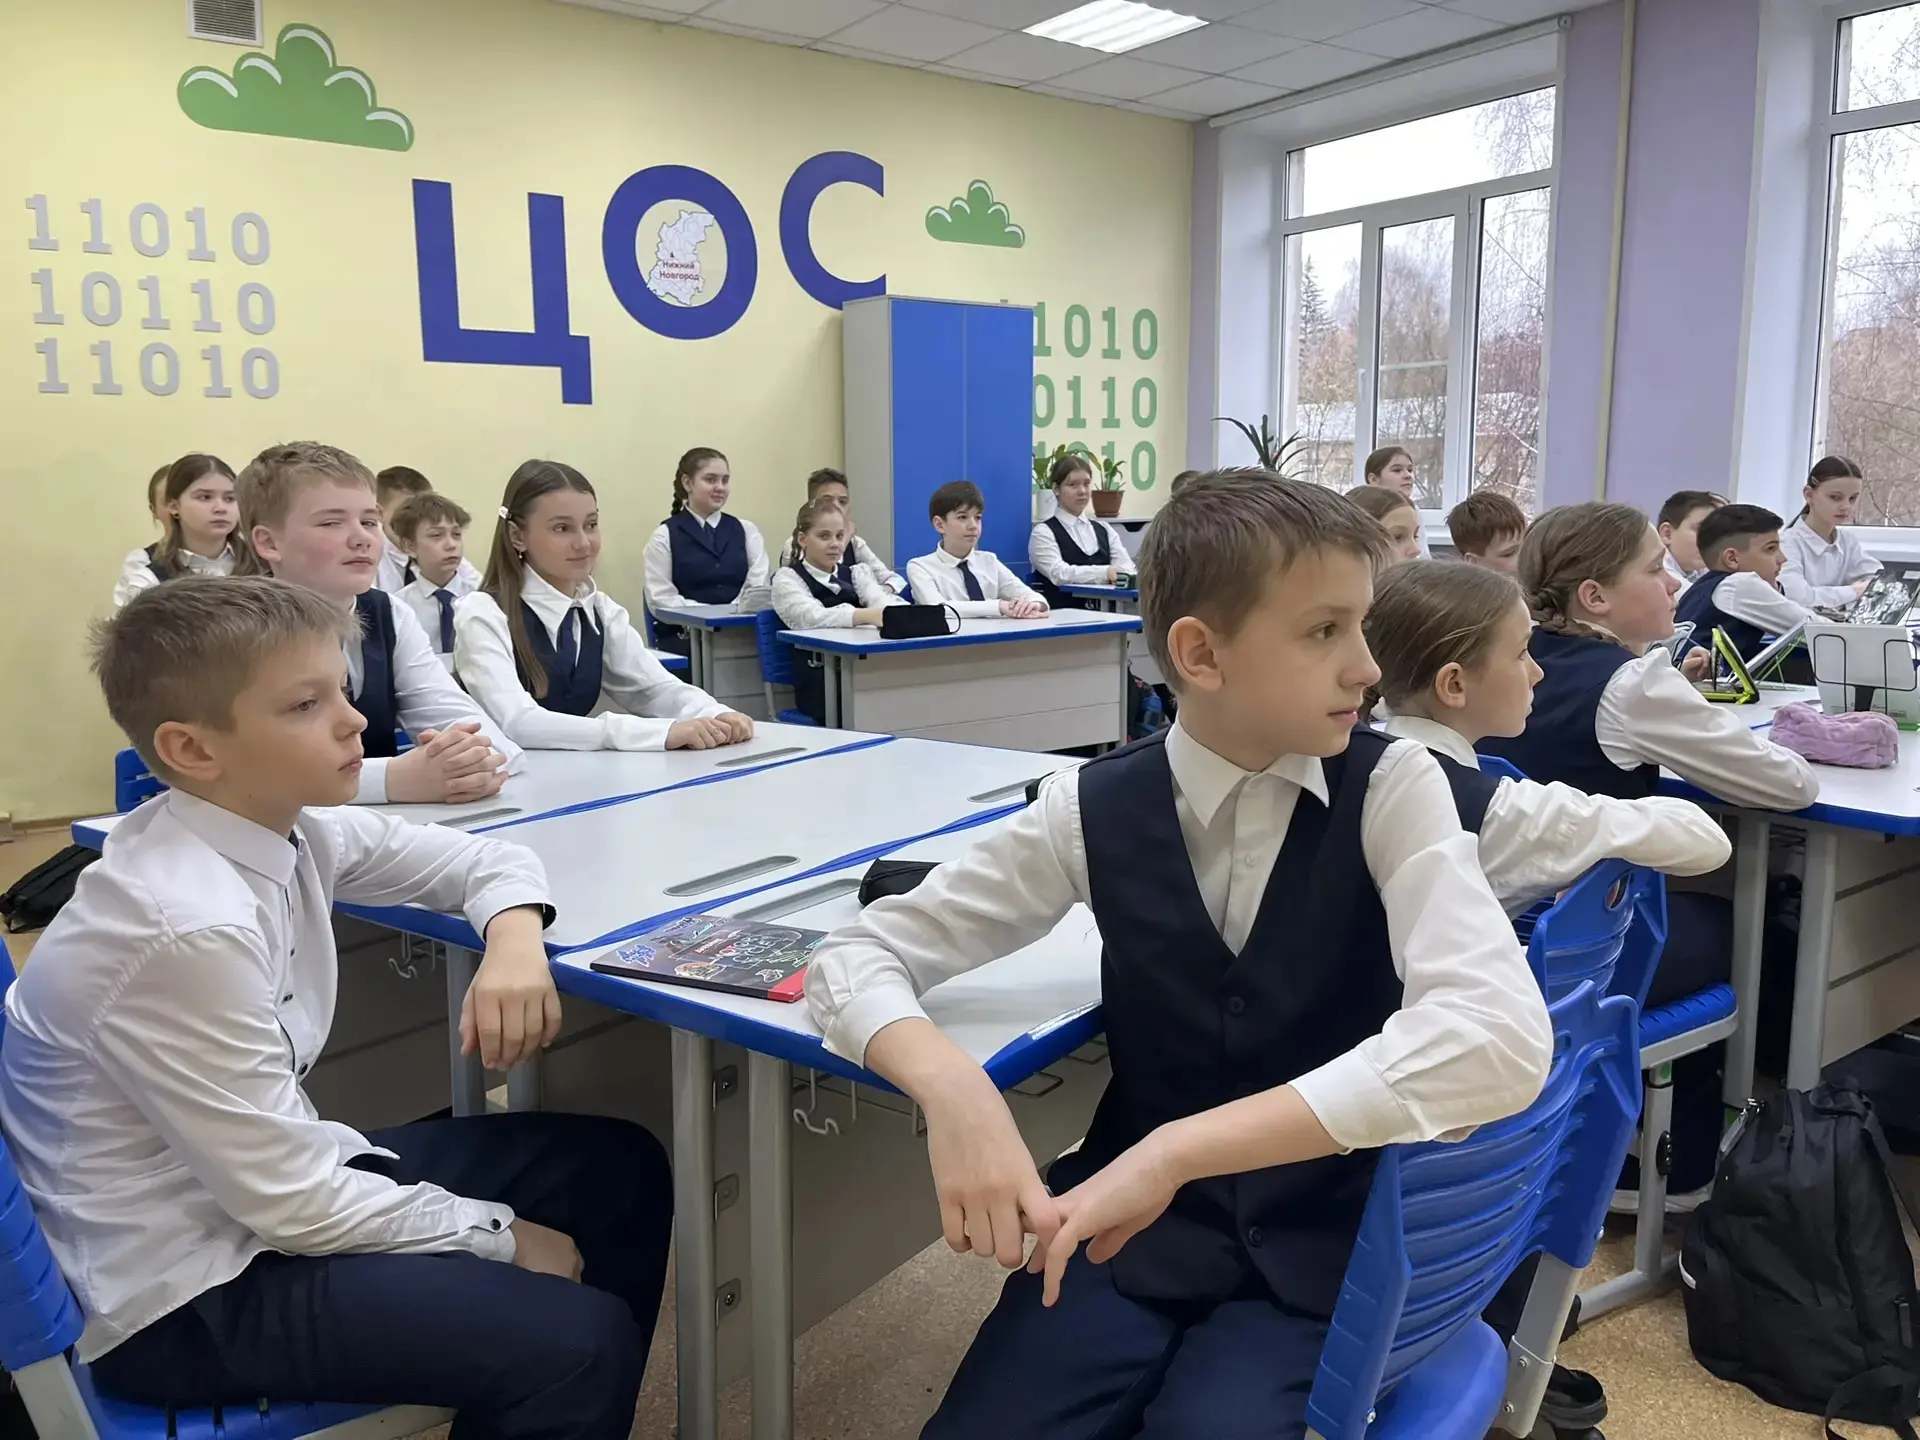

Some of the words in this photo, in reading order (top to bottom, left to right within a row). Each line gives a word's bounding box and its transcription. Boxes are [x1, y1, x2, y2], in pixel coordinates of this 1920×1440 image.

[25, 194, 270, 266] 11010
[412, 151, 886, 405] ЦОС
[659, 271, 700, 281] Новгород
[662, 261, 696, 270] Нижний
[31, 268, 276, 335] 10110
[1000, 299, 1158, 360] 1010
[35, 337, 280, 400] 11010
